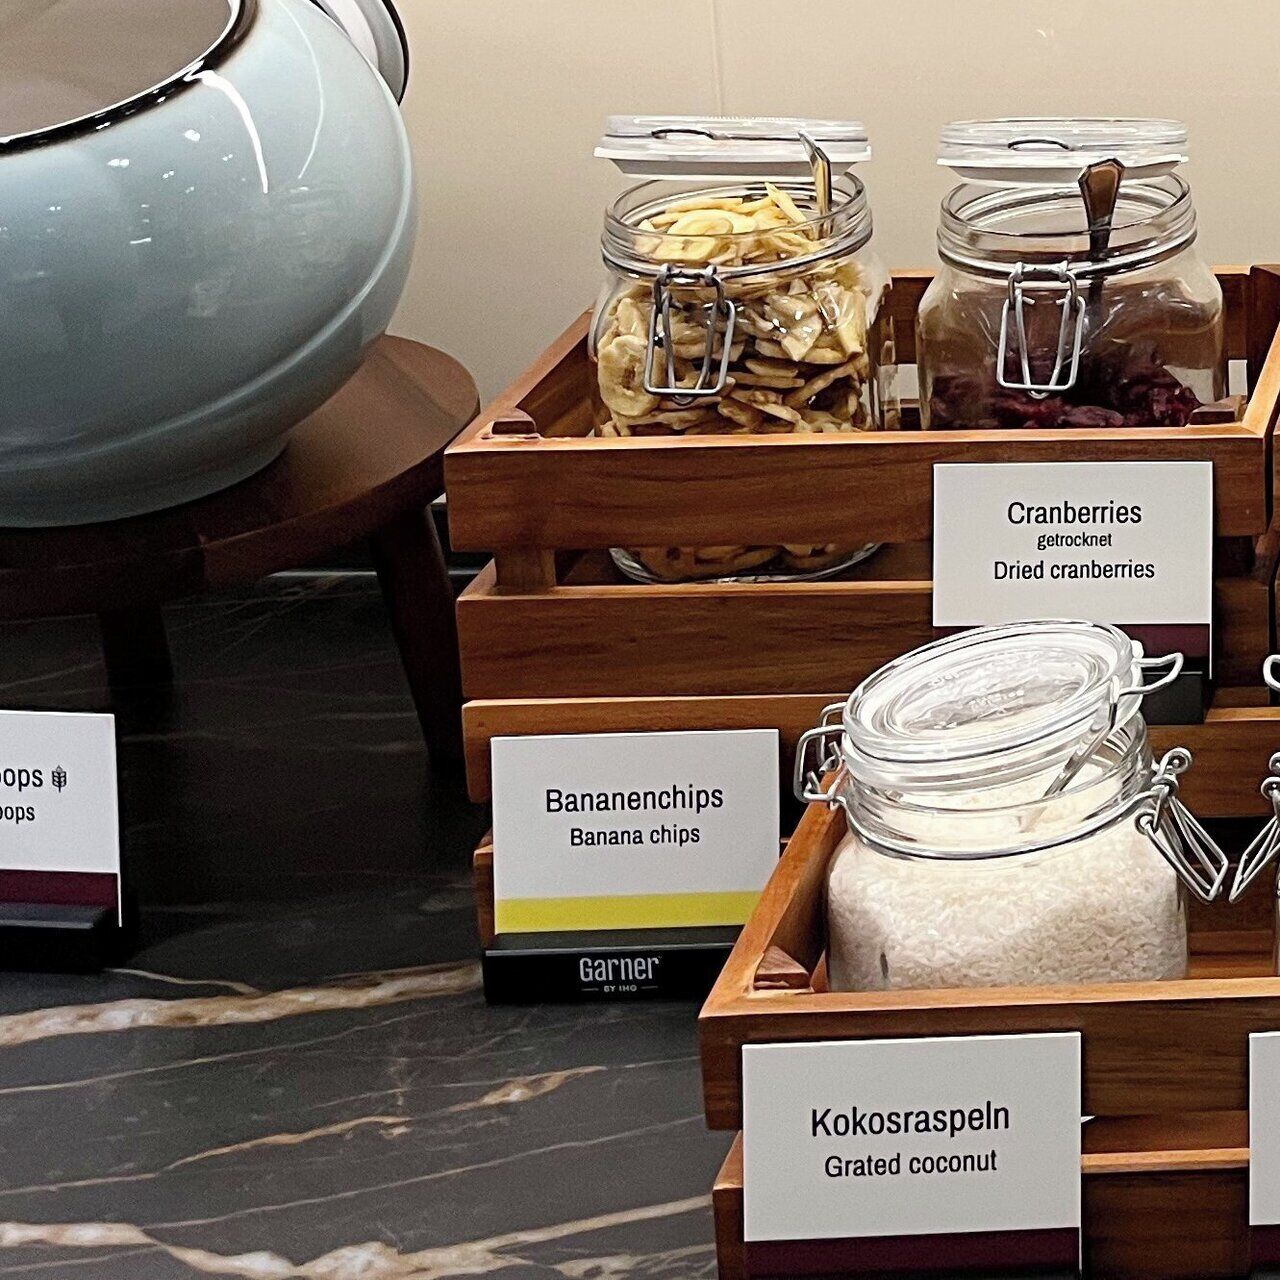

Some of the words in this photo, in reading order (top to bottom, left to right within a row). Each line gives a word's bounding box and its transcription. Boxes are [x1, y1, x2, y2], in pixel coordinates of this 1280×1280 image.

[1007, 499, 1142, 525] Cranberries
[1037, 531, 1113, 551] getrocknet
[994, 559, 1044, 580] Dried
[1050, 558, 1155, 580] cranberries
[0, 768, 44, 793] ops
[546, 783, 724, 815] Bananenchips
[570, 827, 644, 847] Banana
[649, 823, 700, 848] chips
[579, 957, 660, 982] Garner
[811, 1100, 1010, 1139] Kokosraspeln
[824, 1152, 901, 1178] Grated
[908, 1149, 998, 1175] coconut
